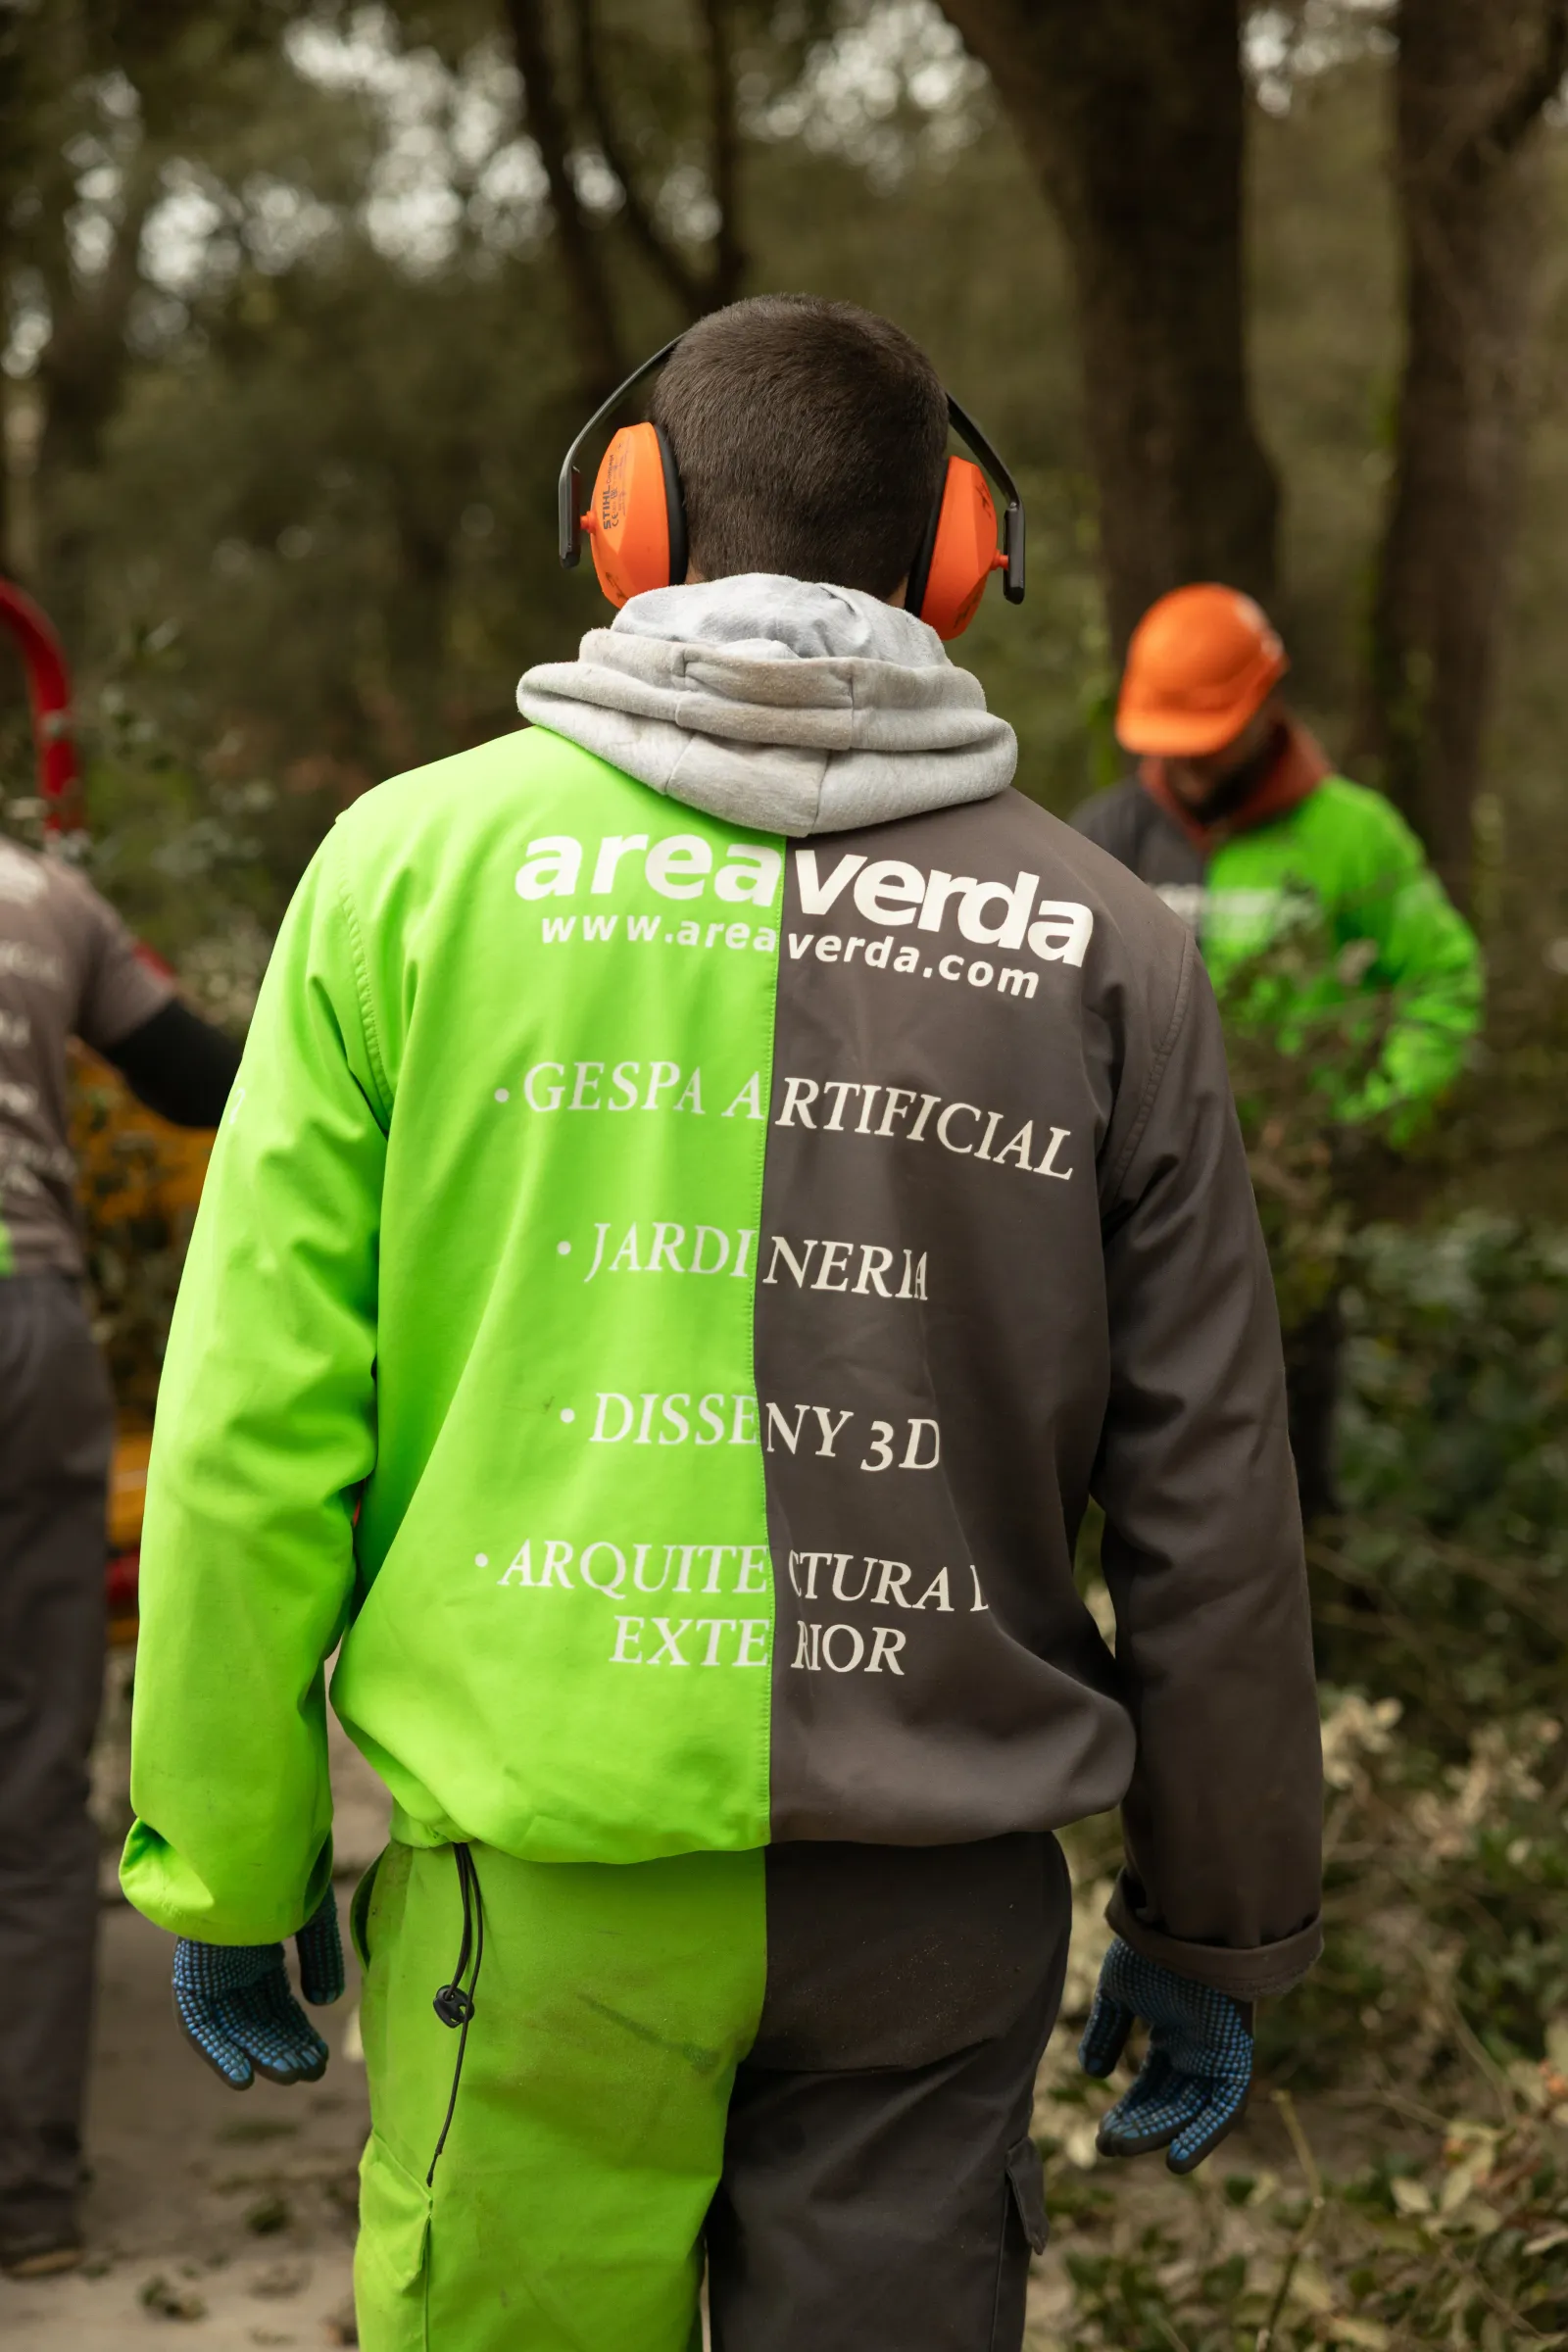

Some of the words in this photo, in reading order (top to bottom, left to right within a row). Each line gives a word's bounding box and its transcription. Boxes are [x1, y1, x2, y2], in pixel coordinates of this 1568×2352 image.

[542, 914, 1040, 1000] www.areaverda.com
[523, 1061, 705, 1115] GESPA
[721, 1071, 1074, 1181] ARTIFICIAL
[583, 1222, 929, 1301] JARDINERIA
[589, 1393, 855, 1458] DISSENY
[859, 1419, 941, 1472] 3D
[609, 1615, 906, 1676] EXTERIOR
